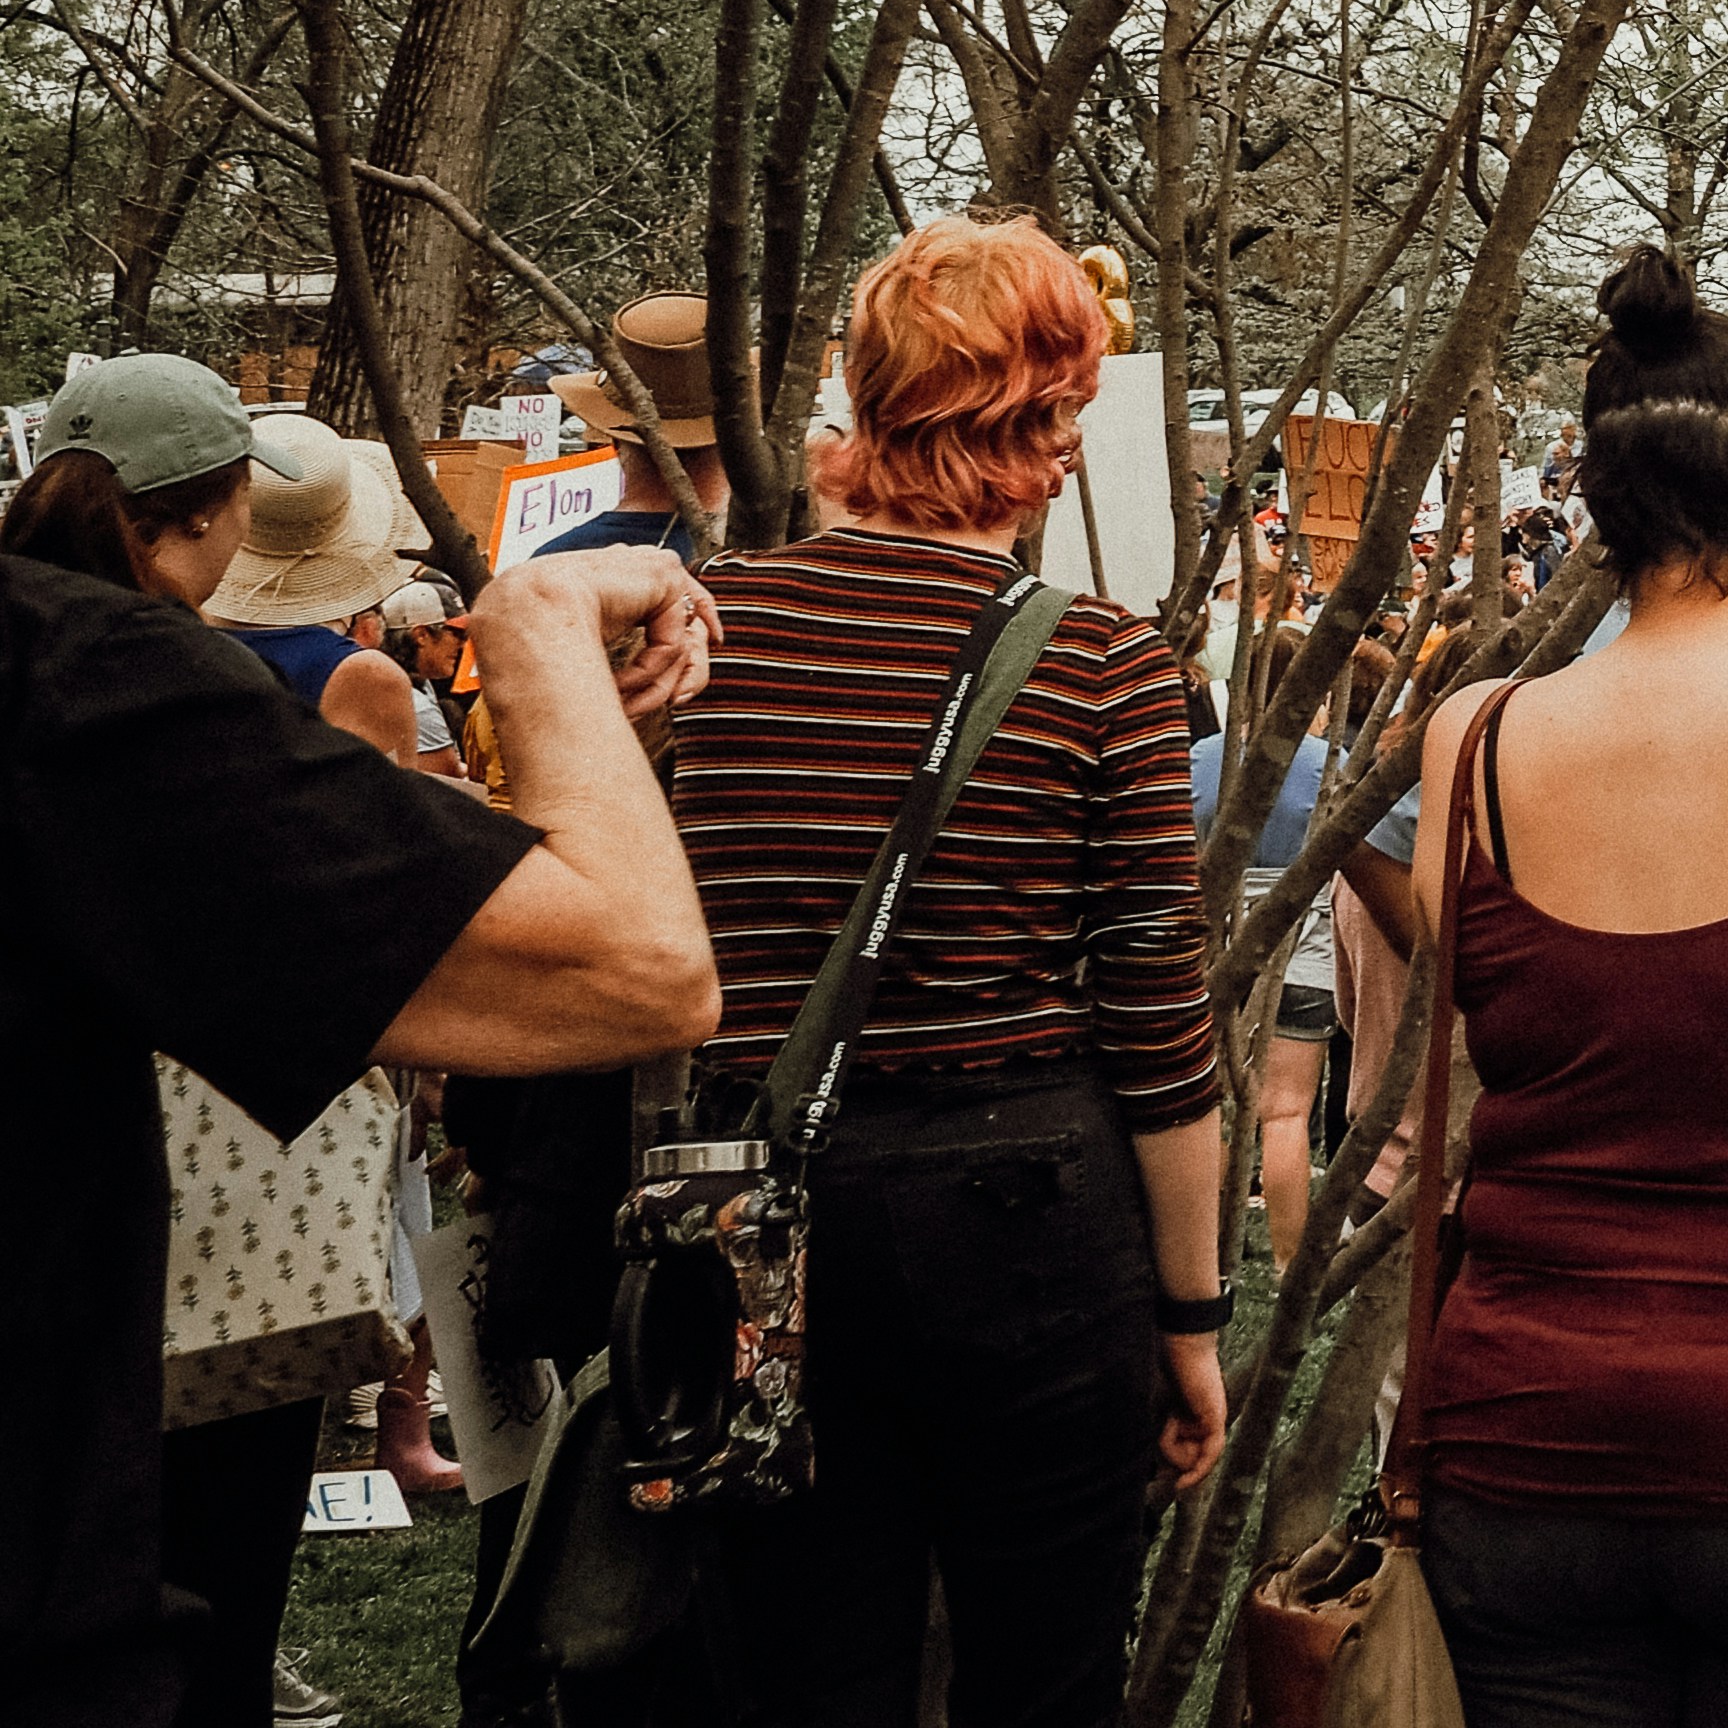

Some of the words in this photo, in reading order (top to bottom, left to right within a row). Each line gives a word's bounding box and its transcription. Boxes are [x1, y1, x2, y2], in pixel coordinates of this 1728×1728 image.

[518, 398, 544, 414] NO
[519, 480, 592, 534] Elon
[923, 672, 973, 775] juggyusa.com
[859, 852, 908, 960] juggyusa.com
[305, 1475, 373, 1523] E!
